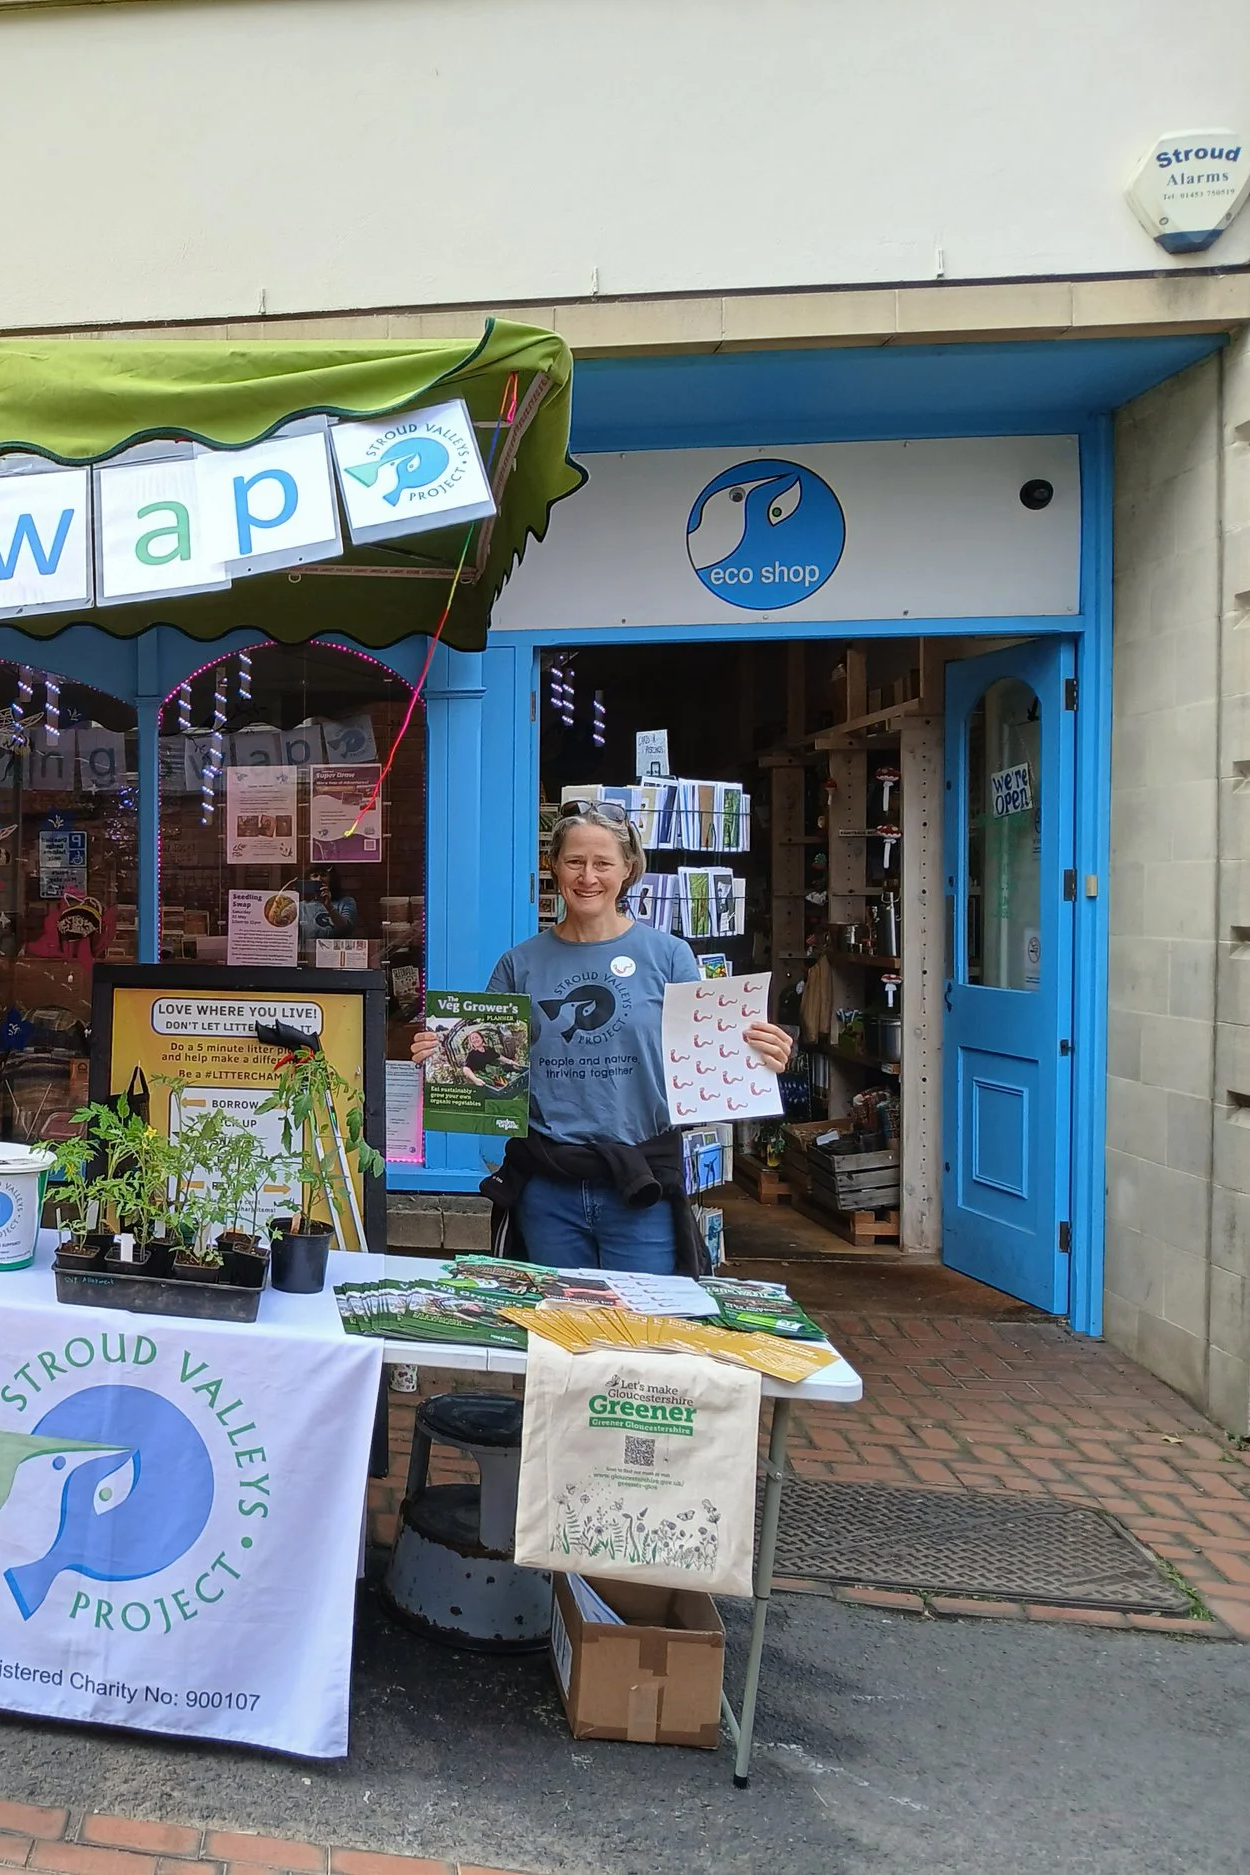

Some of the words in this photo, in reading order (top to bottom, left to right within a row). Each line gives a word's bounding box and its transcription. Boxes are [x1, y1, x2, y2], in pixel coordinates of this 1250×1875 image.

[1156, 146, 1241, 168] Stroud
[1166, 171, 1229, 186] Alarms
[366, 423, 417, 457] STROUD
[425, 423, 470, 457] VALLEYS
[409, 466, 466, 501] PROJECT
[711, 567, 753, 584] eco
[760, 561, 820, 587] shop
[316, 772, 335, 780] Super
[233, 893, 262, 901] Seedling
[554, 971, 599, 995] STROUD
[604, 973, 632, 1009] VALLEYS
[158, 1004, 192, 1015] LOVE
[196, 1005, 244, 1016] WHERE
[249, 1006, 277, 1018] YOU
[282, 1008, 317, 1019] LIVE!
[437, 999, 460, 1013] Veg
[463, 1000, 519, 1014] Grower's
[165, 1021, 198, 1030] DON'T
[201, 1022, 221, 1031] LET
[578, 1017, 626, 1044] PROJECT
[170, 1042, 184, 1051] Do
[197, 1043, 203, 1051] 5
[207, 1043, 244, 1053] minute
[247, 1044, 274, 1054] litter
[161, 1053, 181, 1061] and
[184, 1053, 208, 1063] help
[211, 1054, 240, 1063] make
[539, 1056, 574, 1068] People
[579, 1056, 600, 1066] and
[205, 1071, 294, 1081] #LITTERCHAM!
[546, 1069, 586, 1080] thriving
[591, 1067, 634, 1079] together
[440, 1086, 472, 1094] sustainably
[212, 1099, 259, 1109] BORROW
[452, 1099, 481, 1107] vegetables
[242, 1119, 257, 1128] UP
[5, 1182, 24, 1212] VALLEYS
[621, 1380, 645, 1391] Let's
[647, 1385, 678, 1396] make
[608, 1388, 694, 1407] Gloucestershire
[589, 1394, 697, 1423] Greener
[0, 1332, 157, 1412] STROUD
[179, 1350, 271, 1520] VALLEYS
[592, 1418, 624, 1427] Greener
[625, 1420, 691, 1435] Gloucestershire
[69, 1551, 242, 1635] PROJECT
[70, 1671, 139, 1704] Charity
[144, 1687, 179, 1707] No:
[186, 1691, 261, 1712] 900107
